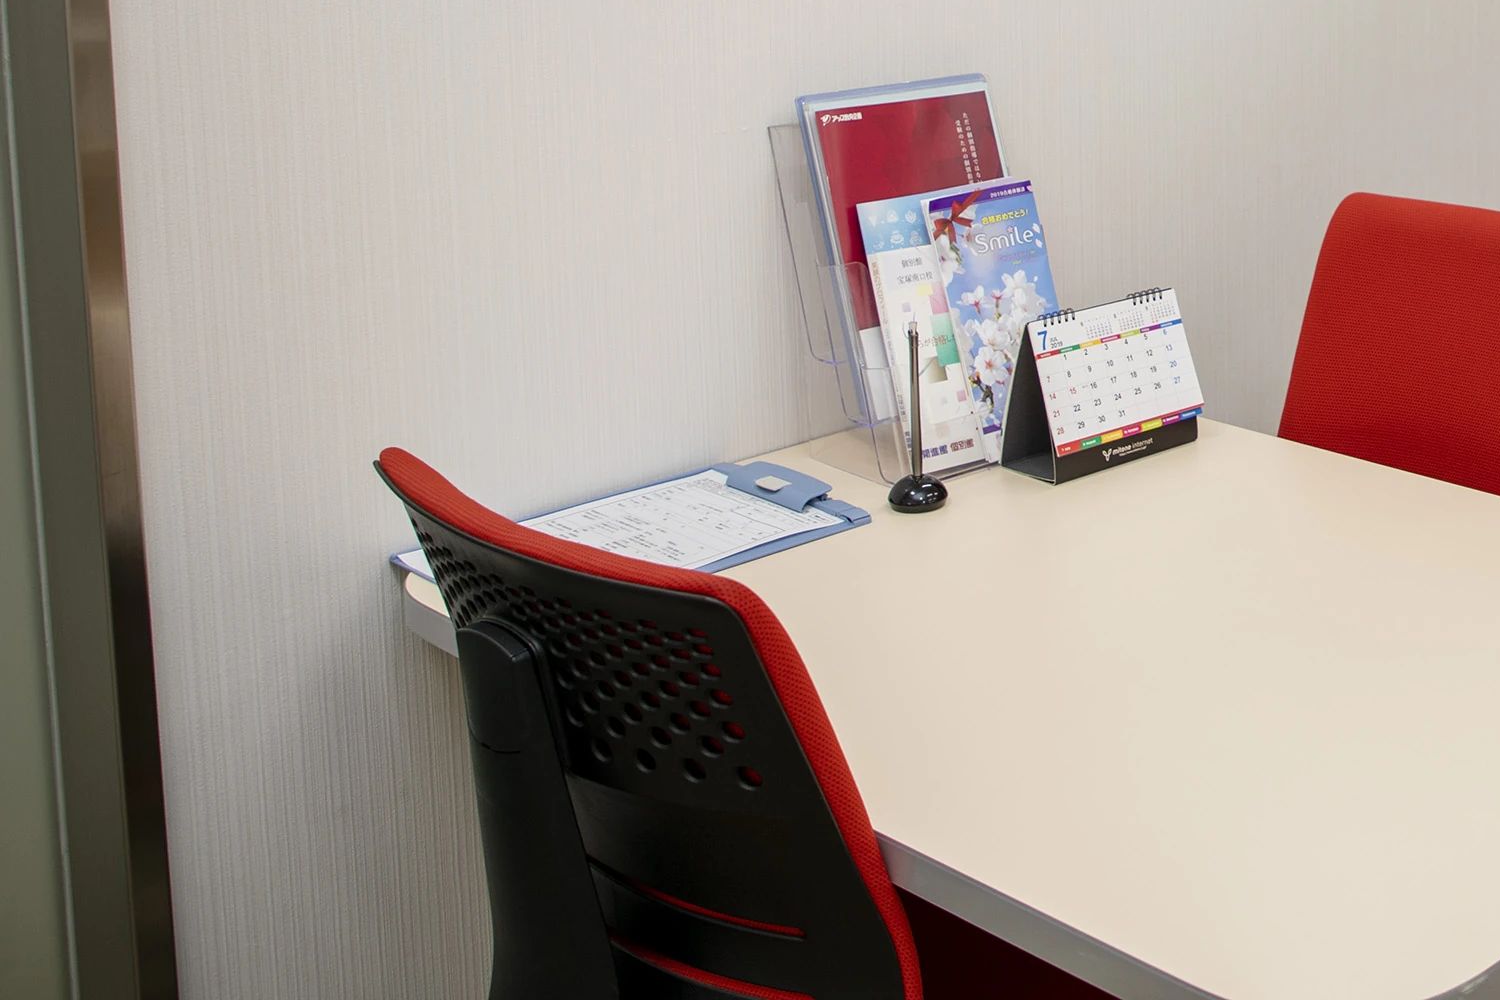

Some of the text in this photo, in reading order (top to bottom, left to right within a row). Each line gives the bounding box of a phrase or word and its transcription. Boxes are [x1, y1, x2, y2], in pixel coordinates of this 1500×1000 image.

[974, 227, 1034, 253] Smile
[1037, 331, 1048, 350] 7
[1051, 341, 1063, 349] 2019
[1106, 344, 1173, 368] 10 11 12 13
[1069, 387, 1077, 395] 15
[1110, 376, 1117, 384] 17
[1130, 371, 1138, 379] 18
[1149, 365, 1157, 373] 19
[1169, 360, 1178, 368] 20
[1053, 376, 1181, 418] 21 22 23 24 25 26 27
[1056, 409, 1126, 435] 28 29 30 31
